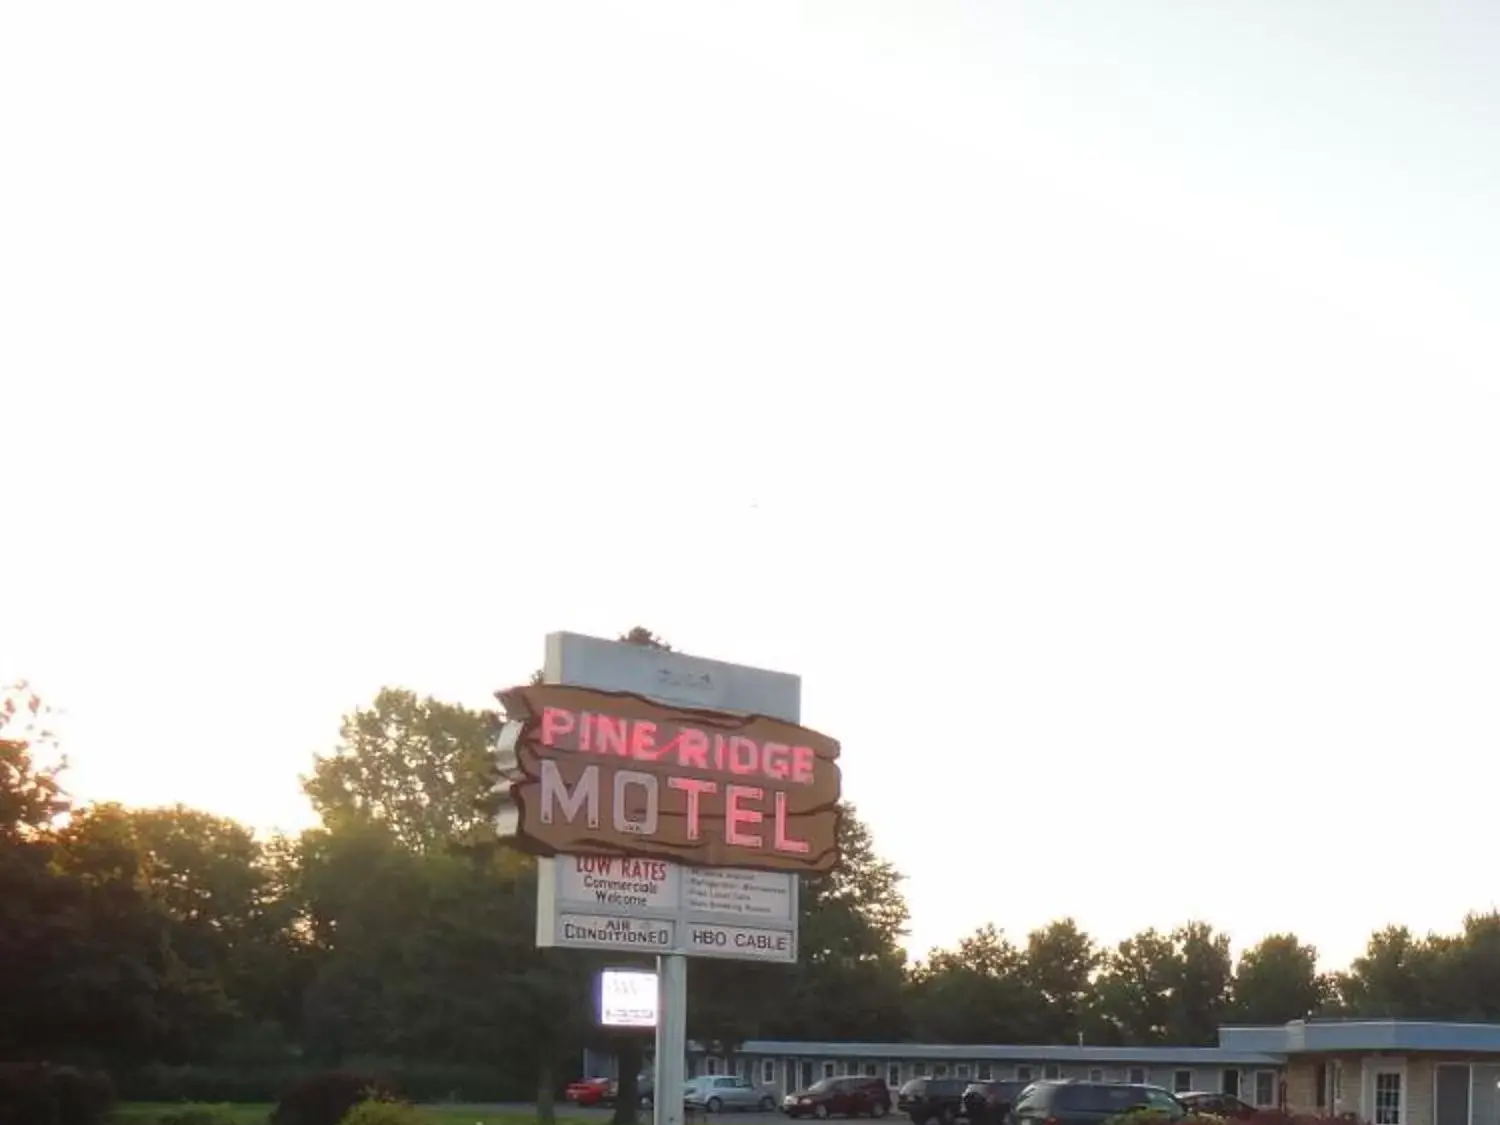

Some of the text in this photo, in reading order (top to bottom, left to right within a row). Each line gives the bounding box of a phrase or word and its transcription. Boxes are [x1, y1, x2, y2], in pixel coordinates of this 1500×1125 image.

[541, 707, 815, 785] PINE RIDGE
[539, 757, 810, 853] MOTEL
[576, 856, 611, 876] LOW
[621, 857, 668, 882] RATES
[595, 890, 648, 907] Welcome
[564, 923, 669, 945] CONDITIONED
[605, 919, 631, 931] AIR
[692, 929, 787, 951] HBO CABLE
